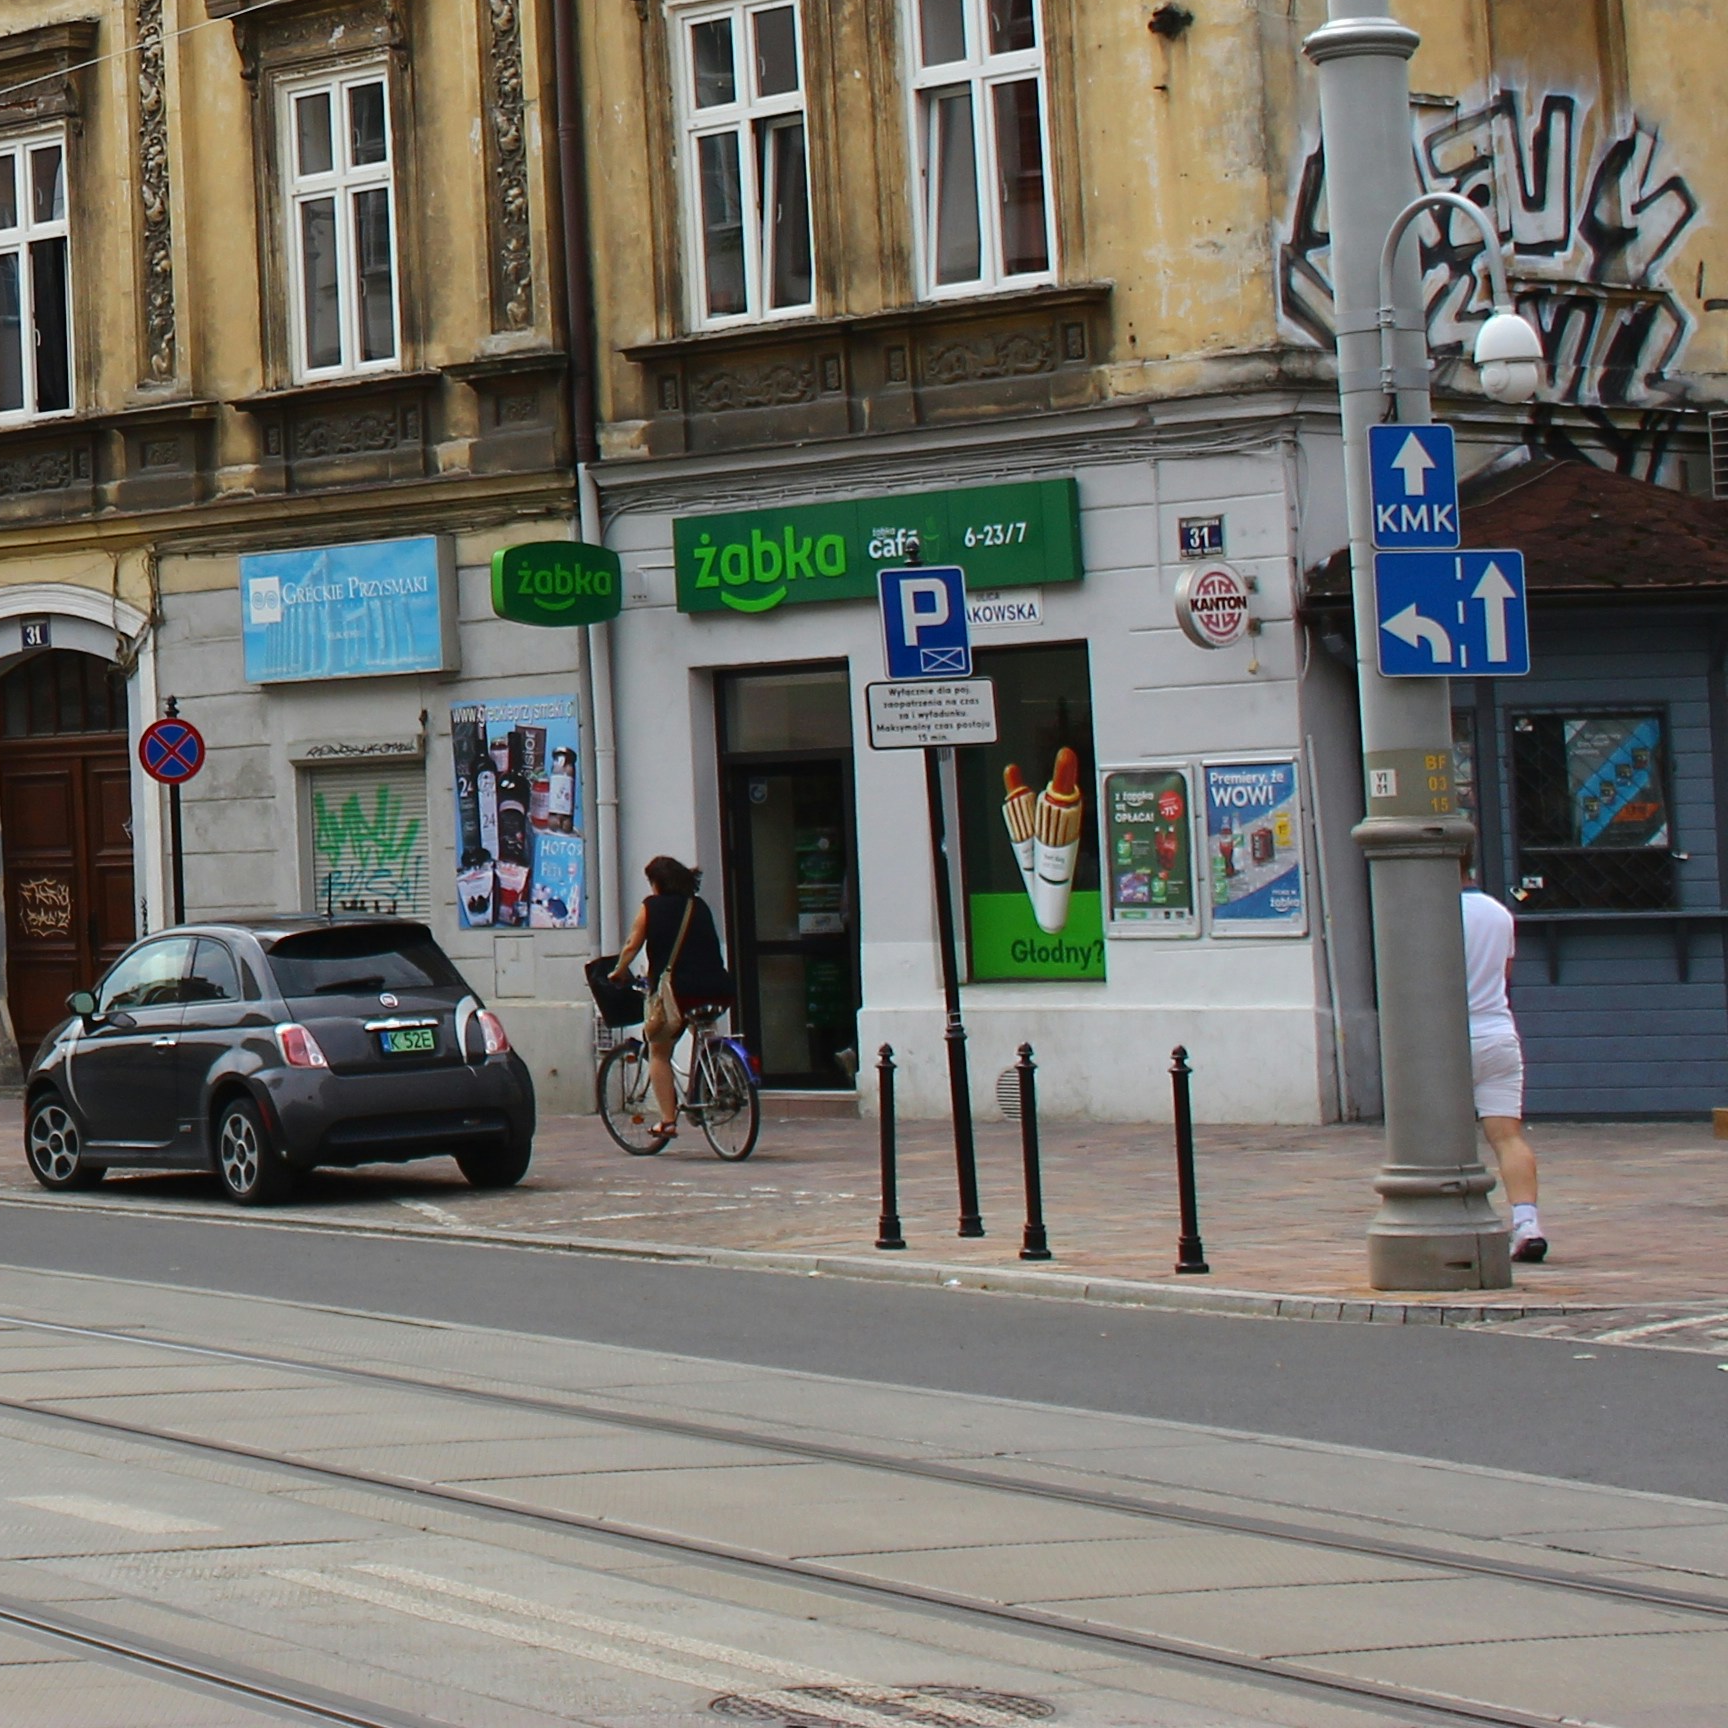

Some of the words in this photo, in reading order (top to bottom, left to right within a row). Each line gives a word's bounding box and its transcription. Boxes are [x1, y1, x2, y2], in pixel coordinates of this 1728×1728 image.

[1376, 504, 1456, 533] KMK
[963, 521, 1028, 548] 6-23/7
[1189, 526, 1210, 549] 31
[693, 525, 845, 590] żabka
[517, 560, 613, 596] żabka
[899, 577, 950, 647] P
[1190, 595, 1248, 613] KANTON
[26, 625, 42, 645] 31
[888, 687, 934, 698] Wyłącznie
[936, 686, 952, 695] dla
[954, 686, 971, 696] poj.
[883, 699, 943, 710] zaopatrzenia
[945, 698, 957, 707] na
[959, 697, 980, 706] czas
[898, 712, 910, 720] za
[917, 709, 967, 720] wyładunku.
[876, 722, 932, 733] Maksymalny
[934, 722, 954, 731] czas
[956, 721, 991, 732] postoju
[917, 734, 927, 742] 15
[930, 734, 949, 742] min.
[1425, 755, 1447, 770] BF
[1270, 770, 1285, 783] że
[1427, 776, 1448, 791] 03
[1210, 785, 1275, 808] WOW!
[1430, 797, 1450, 812] 15
[1010, 939, 1105, 971] Głodny?
[390, 1033, 400, 1051] K
[404, 1031, 432, 1050] 52E
